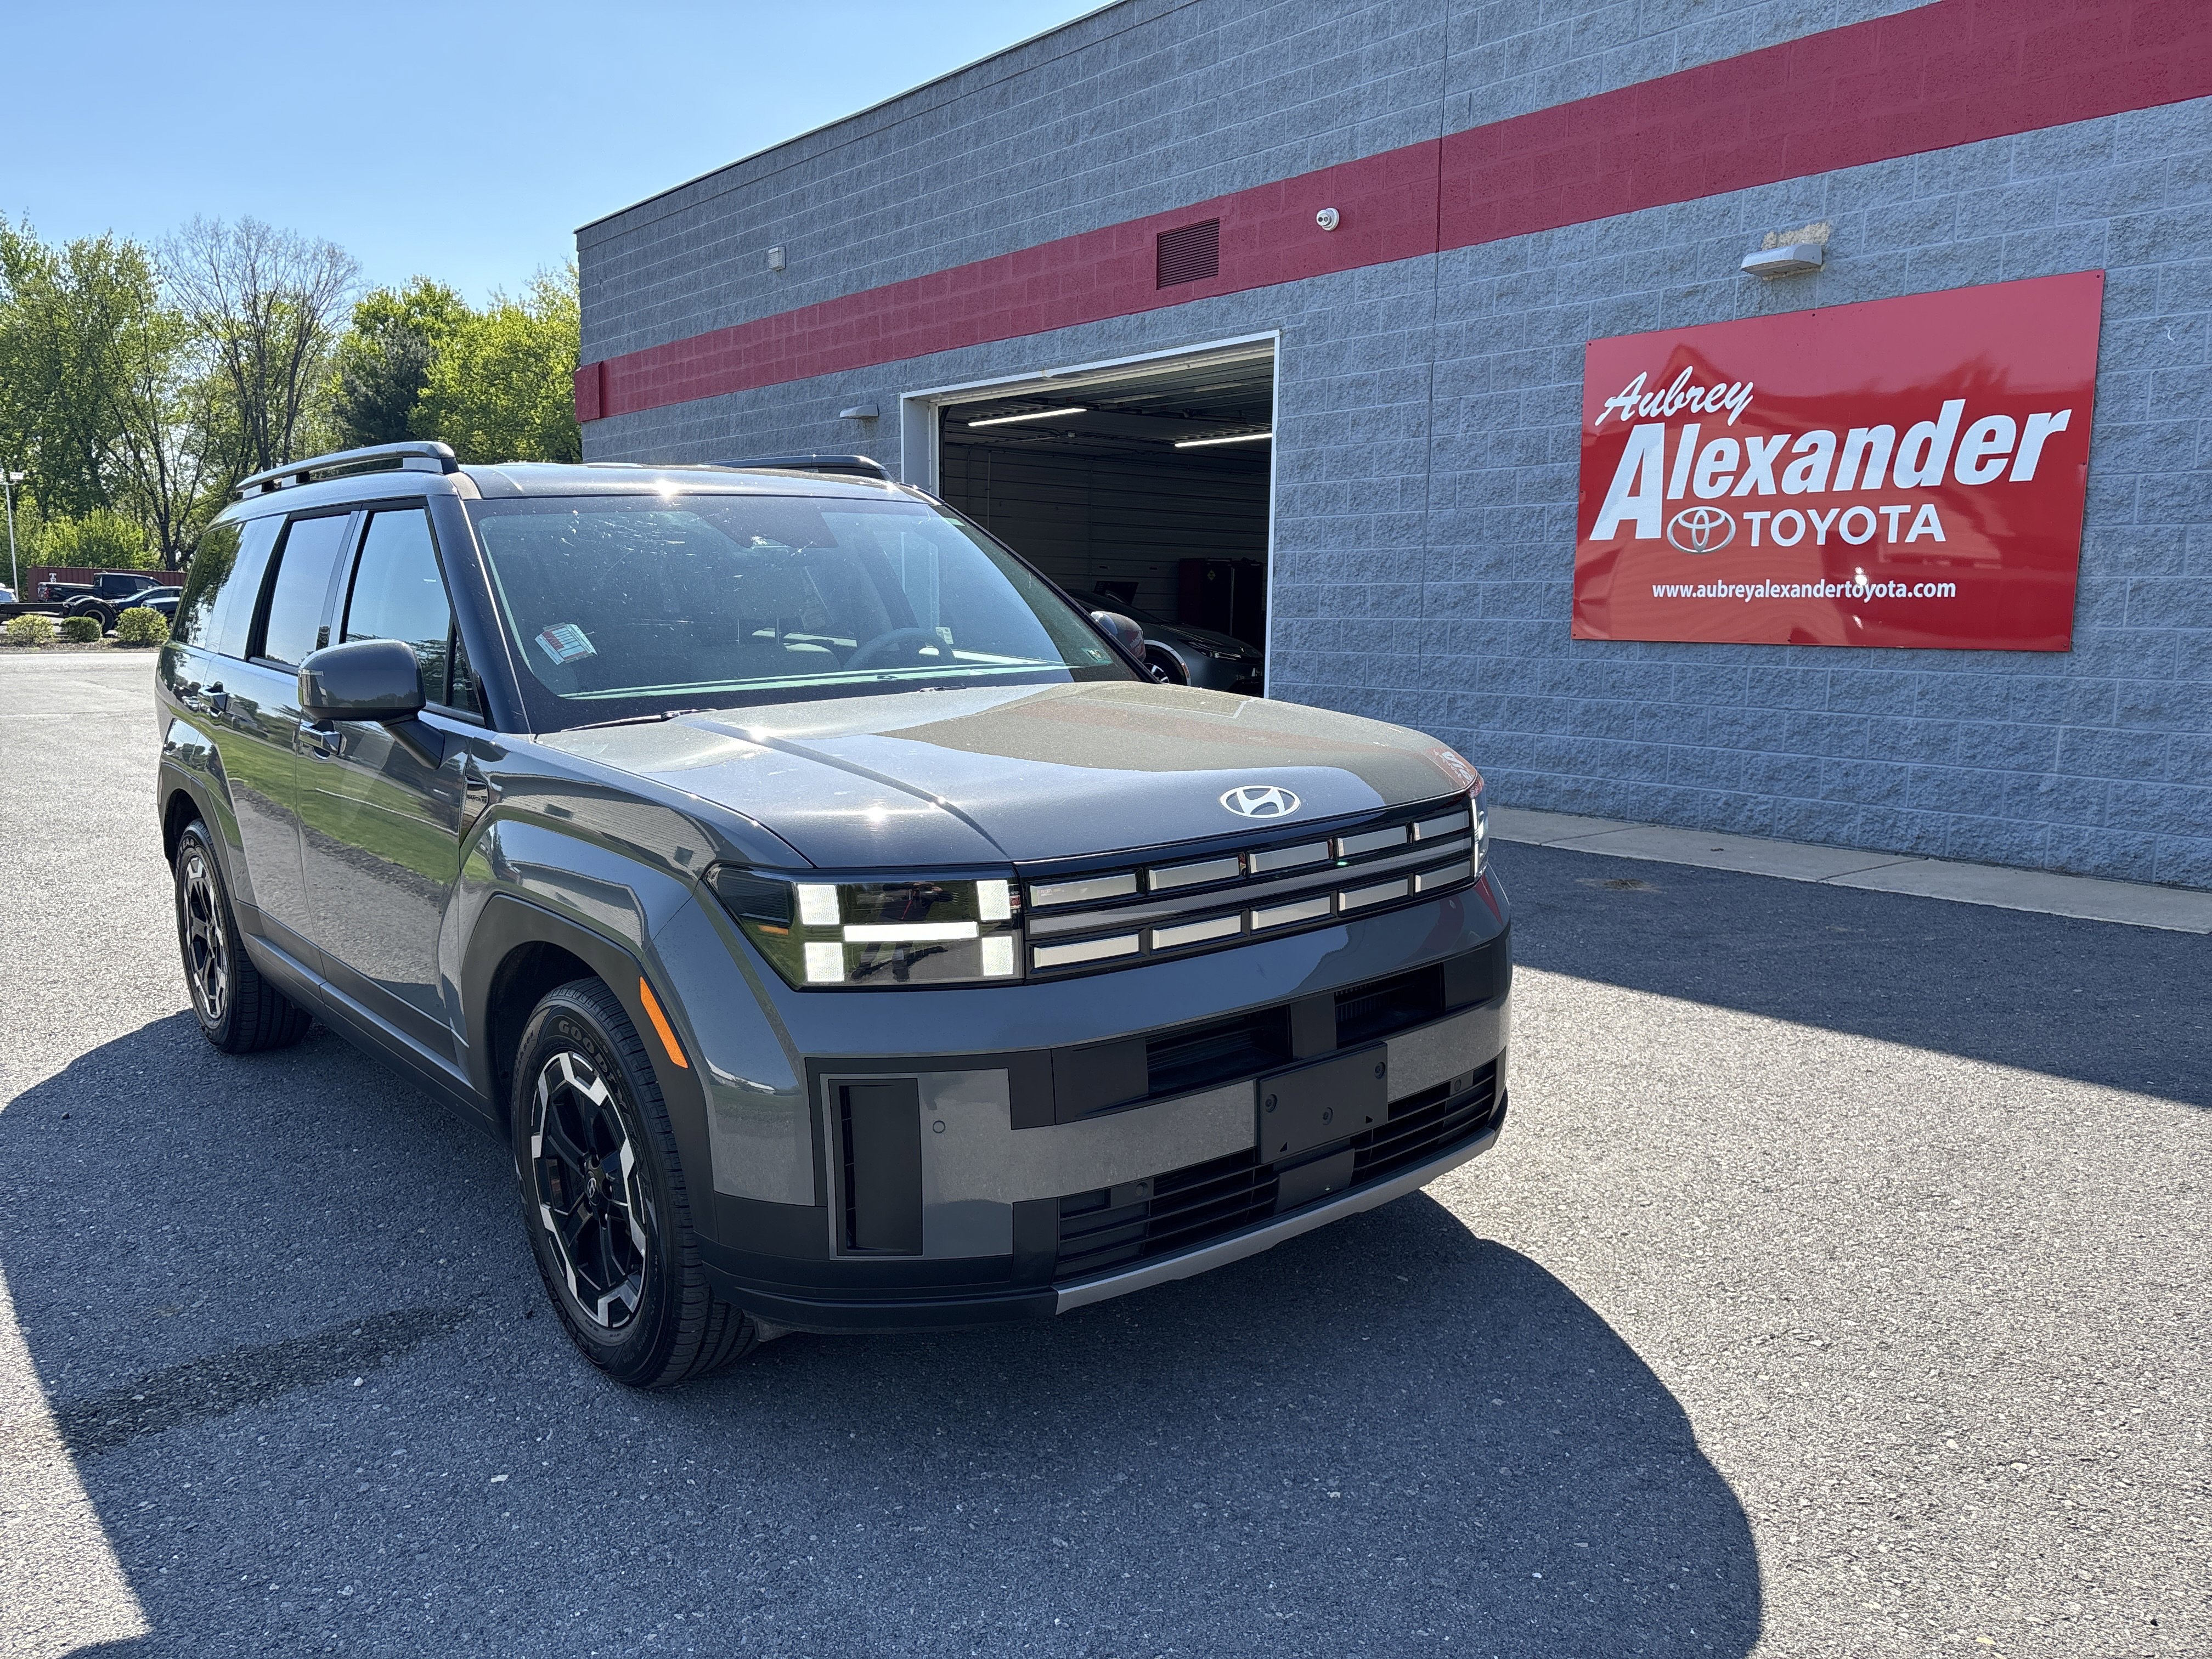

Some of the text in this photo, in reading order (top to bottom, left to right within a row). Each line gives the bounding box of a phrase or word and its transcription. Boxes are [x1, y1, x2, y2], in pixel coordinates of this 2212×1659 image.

[1594, 365, 1753, 426] Aubrey
[1589, 398, 2072, 540] Alexander
[1743, 504, 1946, 547] TOYOTA
[1652, 579, 1956, 603] www.aubreyalexandertoyota.com
